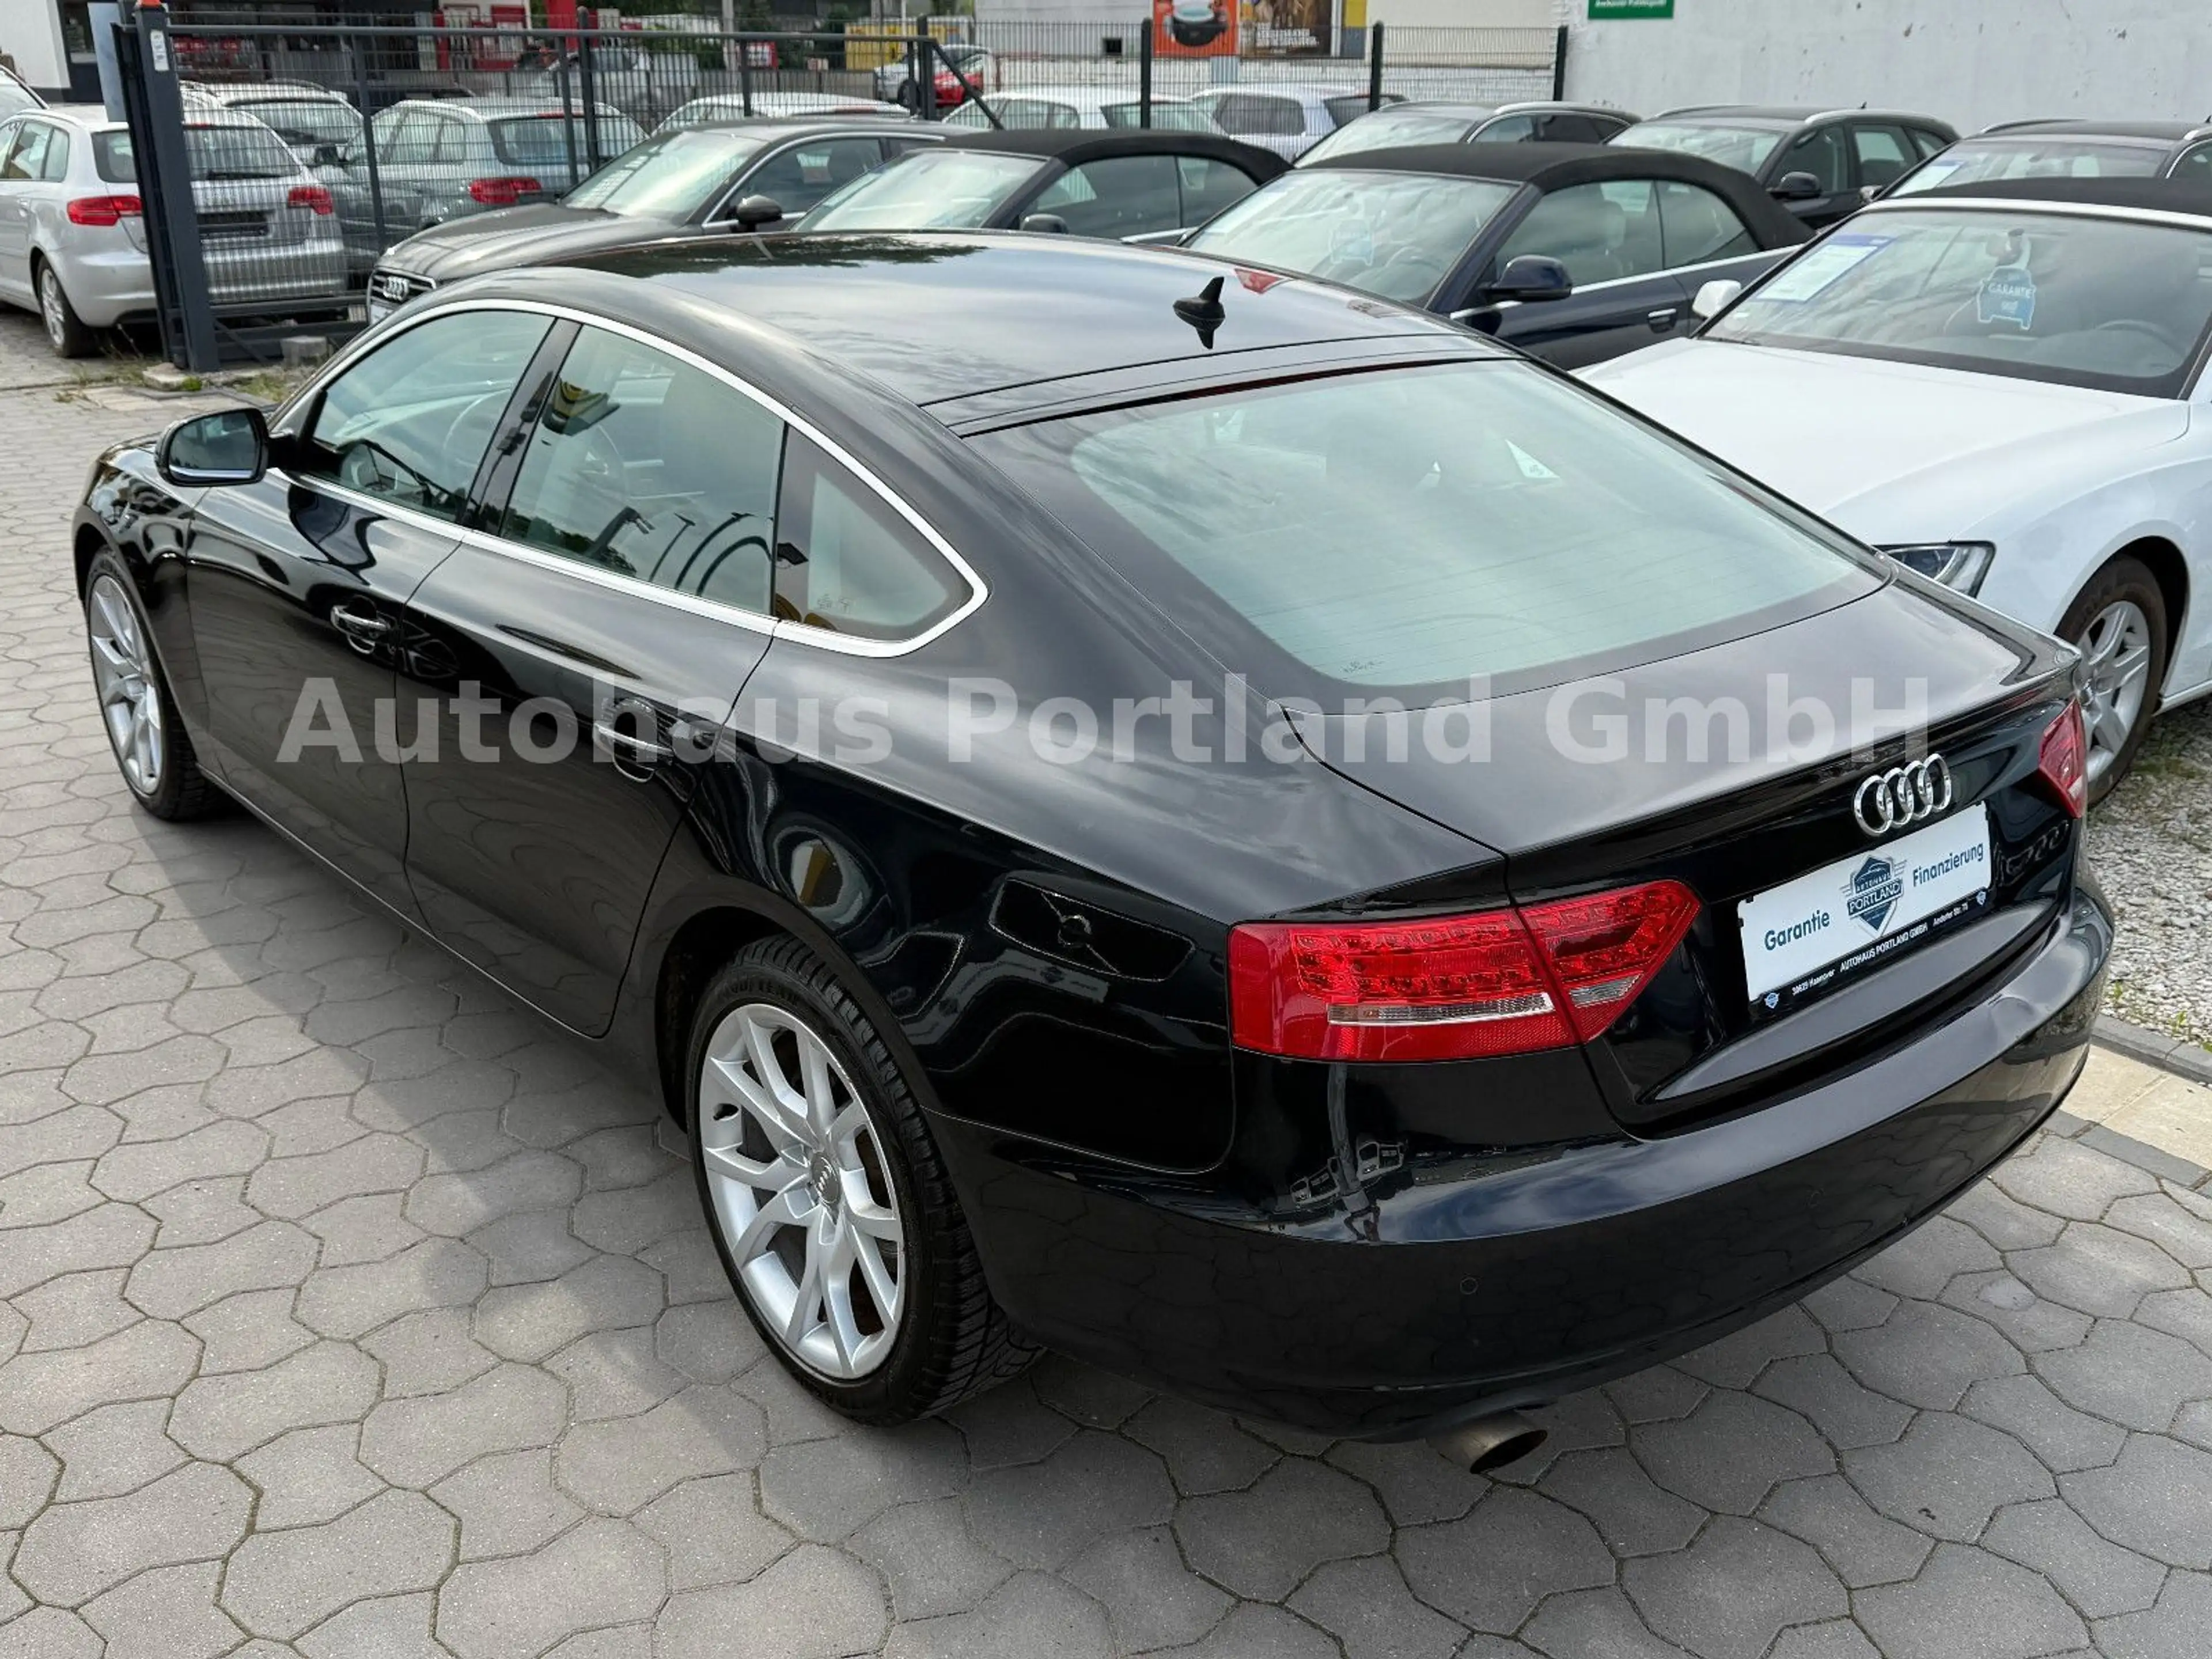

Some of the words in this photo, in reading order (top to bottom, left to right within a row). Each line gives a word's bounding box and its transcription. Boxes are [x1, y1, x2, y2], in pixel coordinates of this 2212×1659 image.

[1913, 843, 1983, 887] Finanzierung
[1849, 882, 1900, 913] PORTLAND
[1764, 909, 1830, 950] Garantie
[1840, 948, 1876, 972] AUTOHAUS
[1876, 932, 1909, 955] PORTLAND
